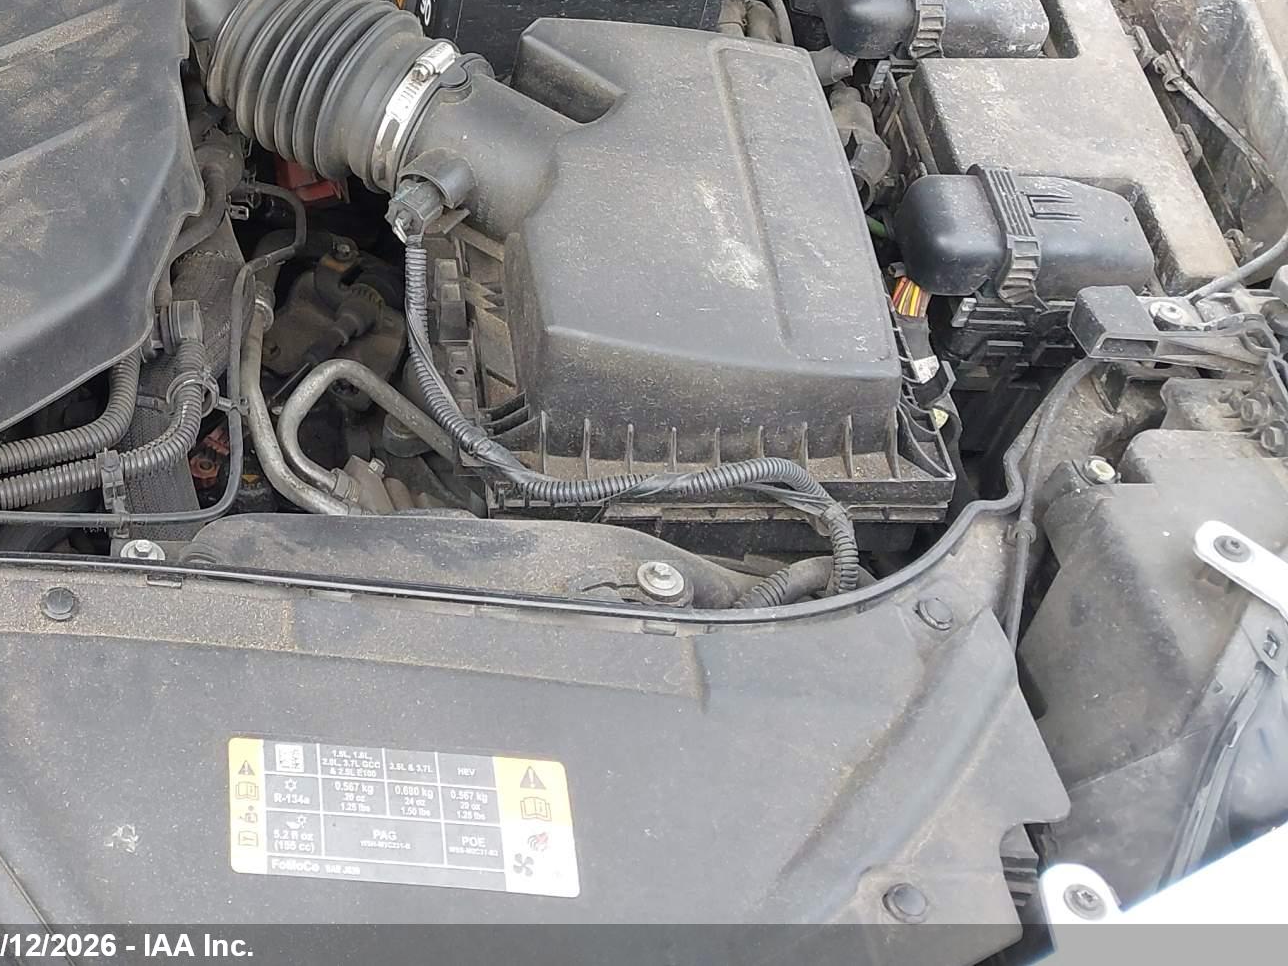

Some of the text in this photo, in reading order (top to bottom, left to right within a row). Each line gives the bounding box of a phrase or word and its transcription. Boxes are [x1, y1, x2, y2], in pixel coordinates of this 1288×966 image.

[335, 781, 374, 796] 0.567 kg
[394, 785, 434, 799] 0.680 kg
[274, 793, 311, 805] R-134a
[404, 797, 426, 807] 24 oz
[450, 790, 488, 804] 0.567 kg
[340, 802, 371, 813] 1.25 lbs
[401, 806, 431, 817] 1.50 lbs
[471, 803, 481, 811] oz
[457, 810, 486, 820] 1.25 lbs
[273, 829, 289, 840] 5.2
[300, 832, 314, 841] oz
[373, 829, 398, 841] PAG
[298, 841, 315, 854] cc)
[461, 836, 486, 848] POE
[272, 857, 320, 872] FoMoCo
